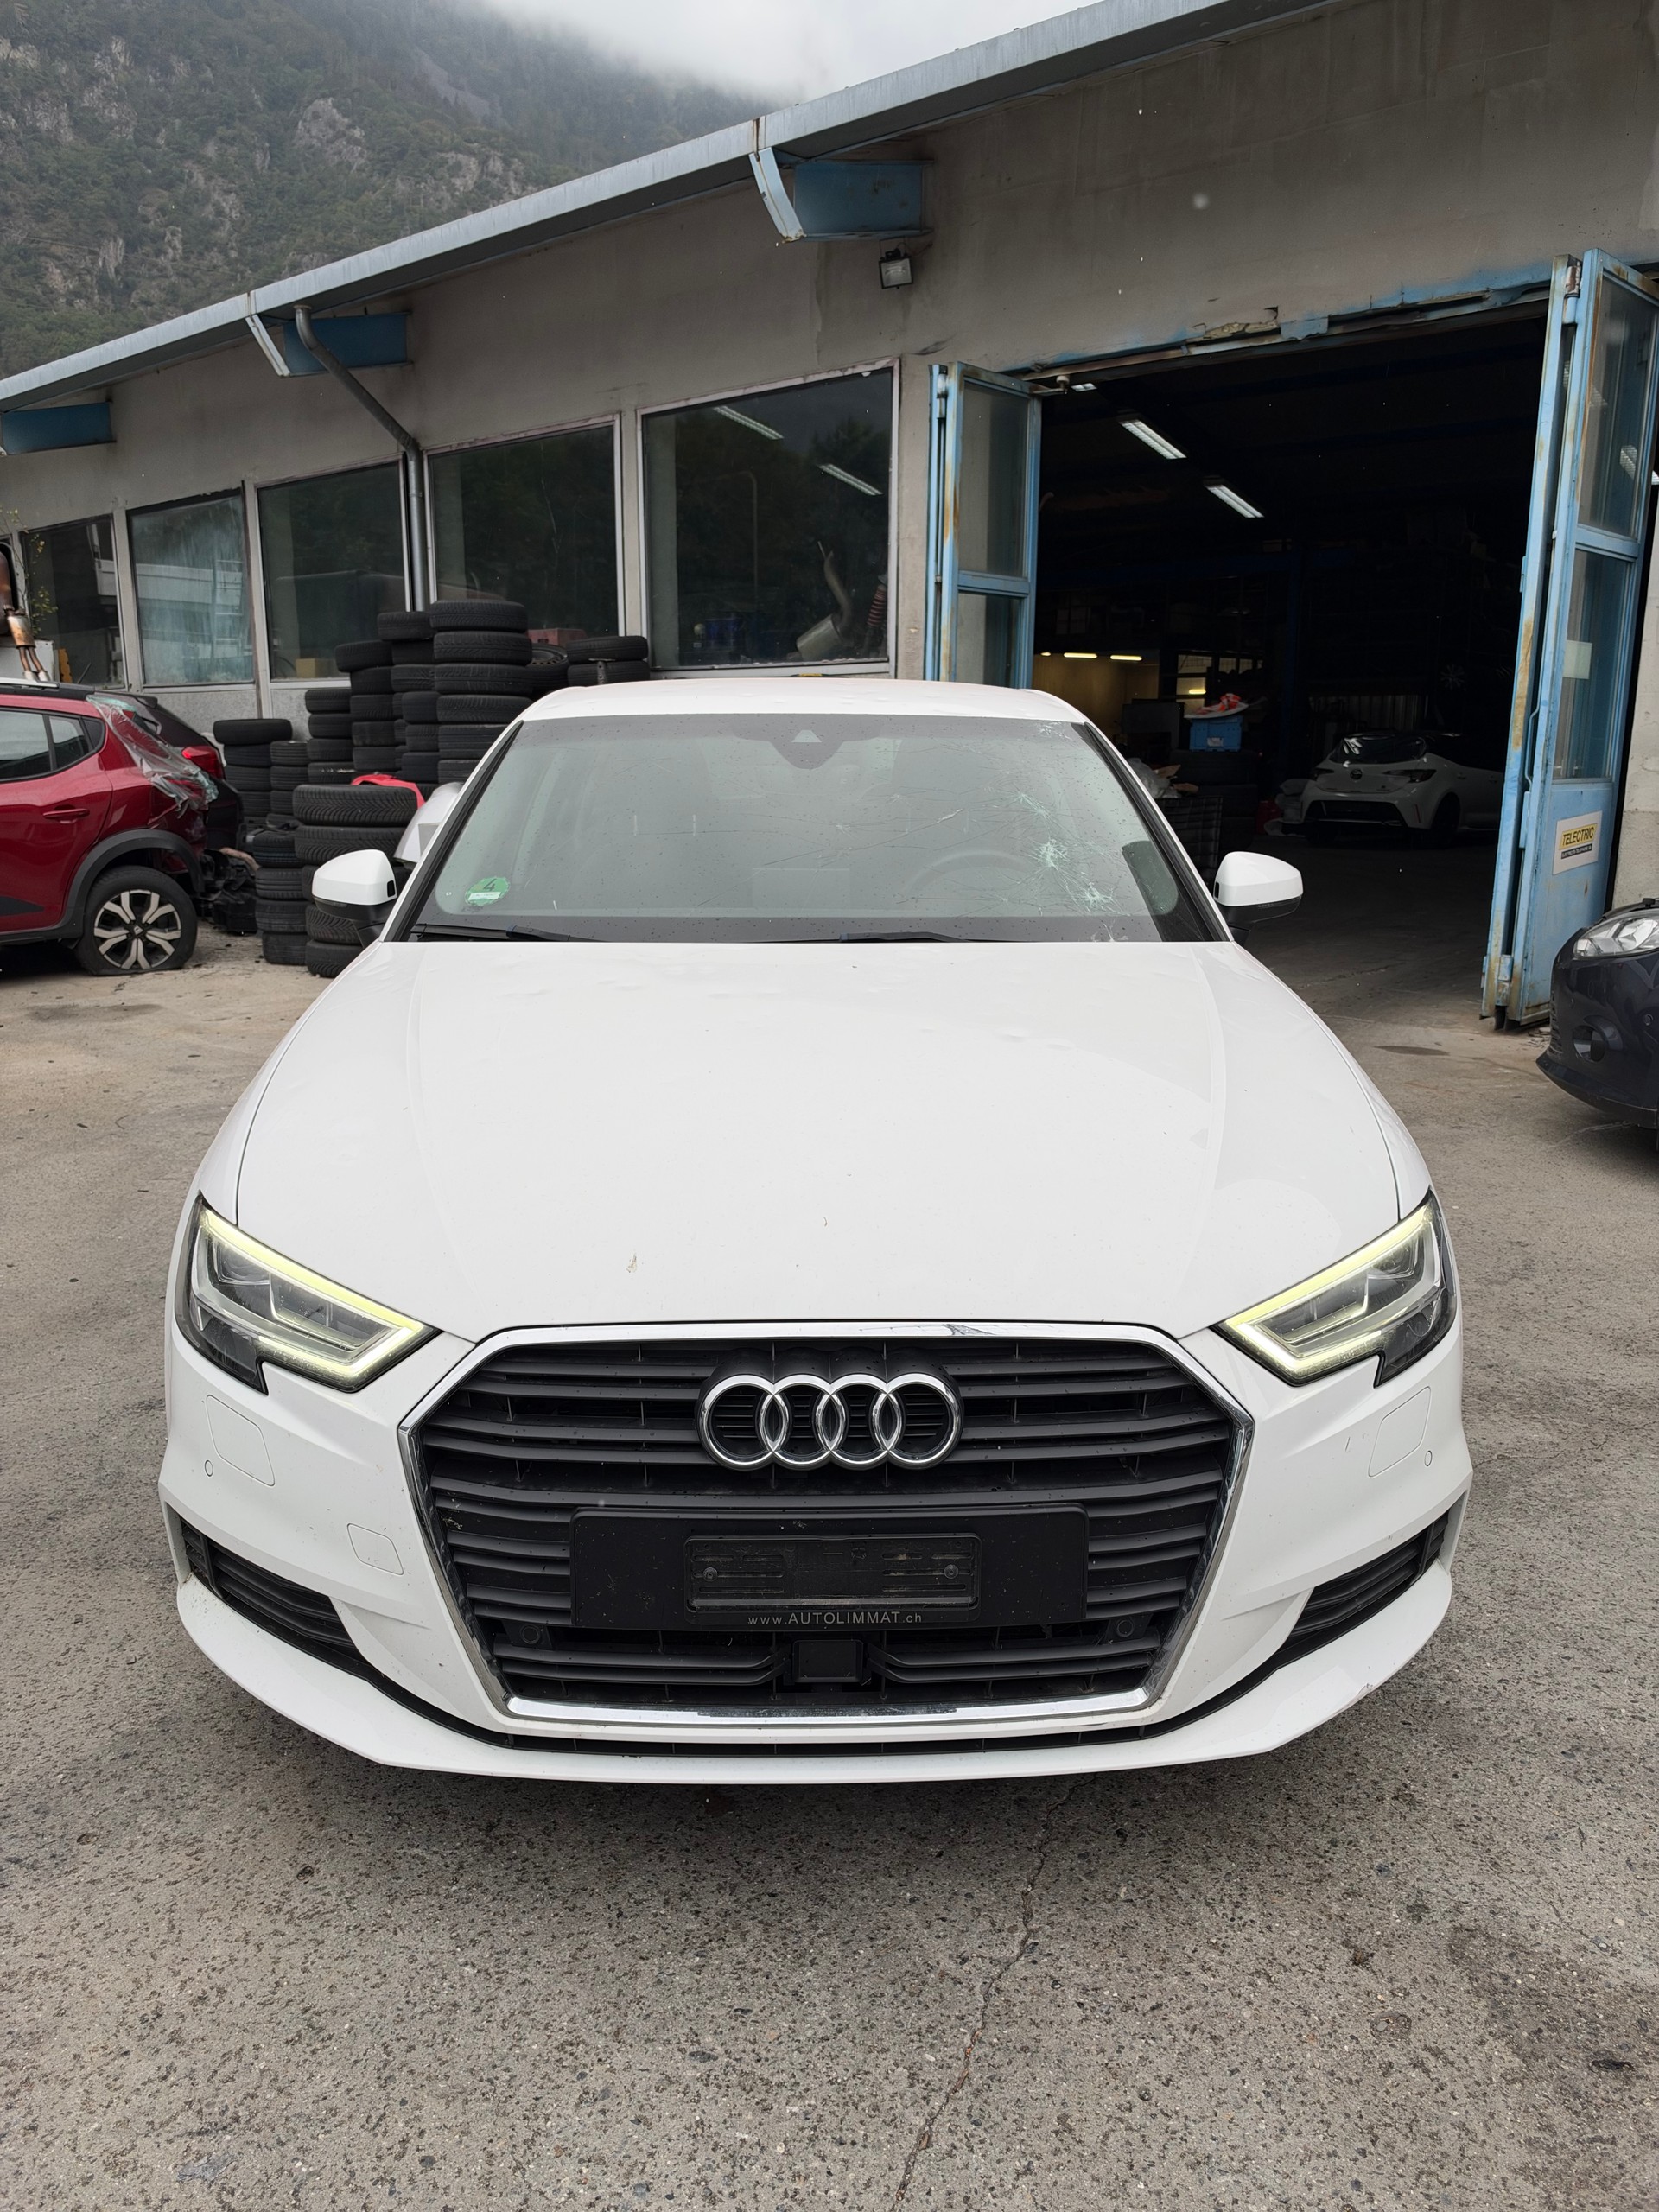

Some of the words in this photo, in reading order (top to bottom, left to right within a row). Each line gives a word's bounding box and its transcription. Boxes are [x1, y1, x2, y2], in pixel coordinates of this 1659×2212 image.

[1562, 826, 1595, 846] TELECTRIC
[483, 878, 497, 891] 4
[747, 1611, 923, 1625] www.AUTOLIMMAT.ch
